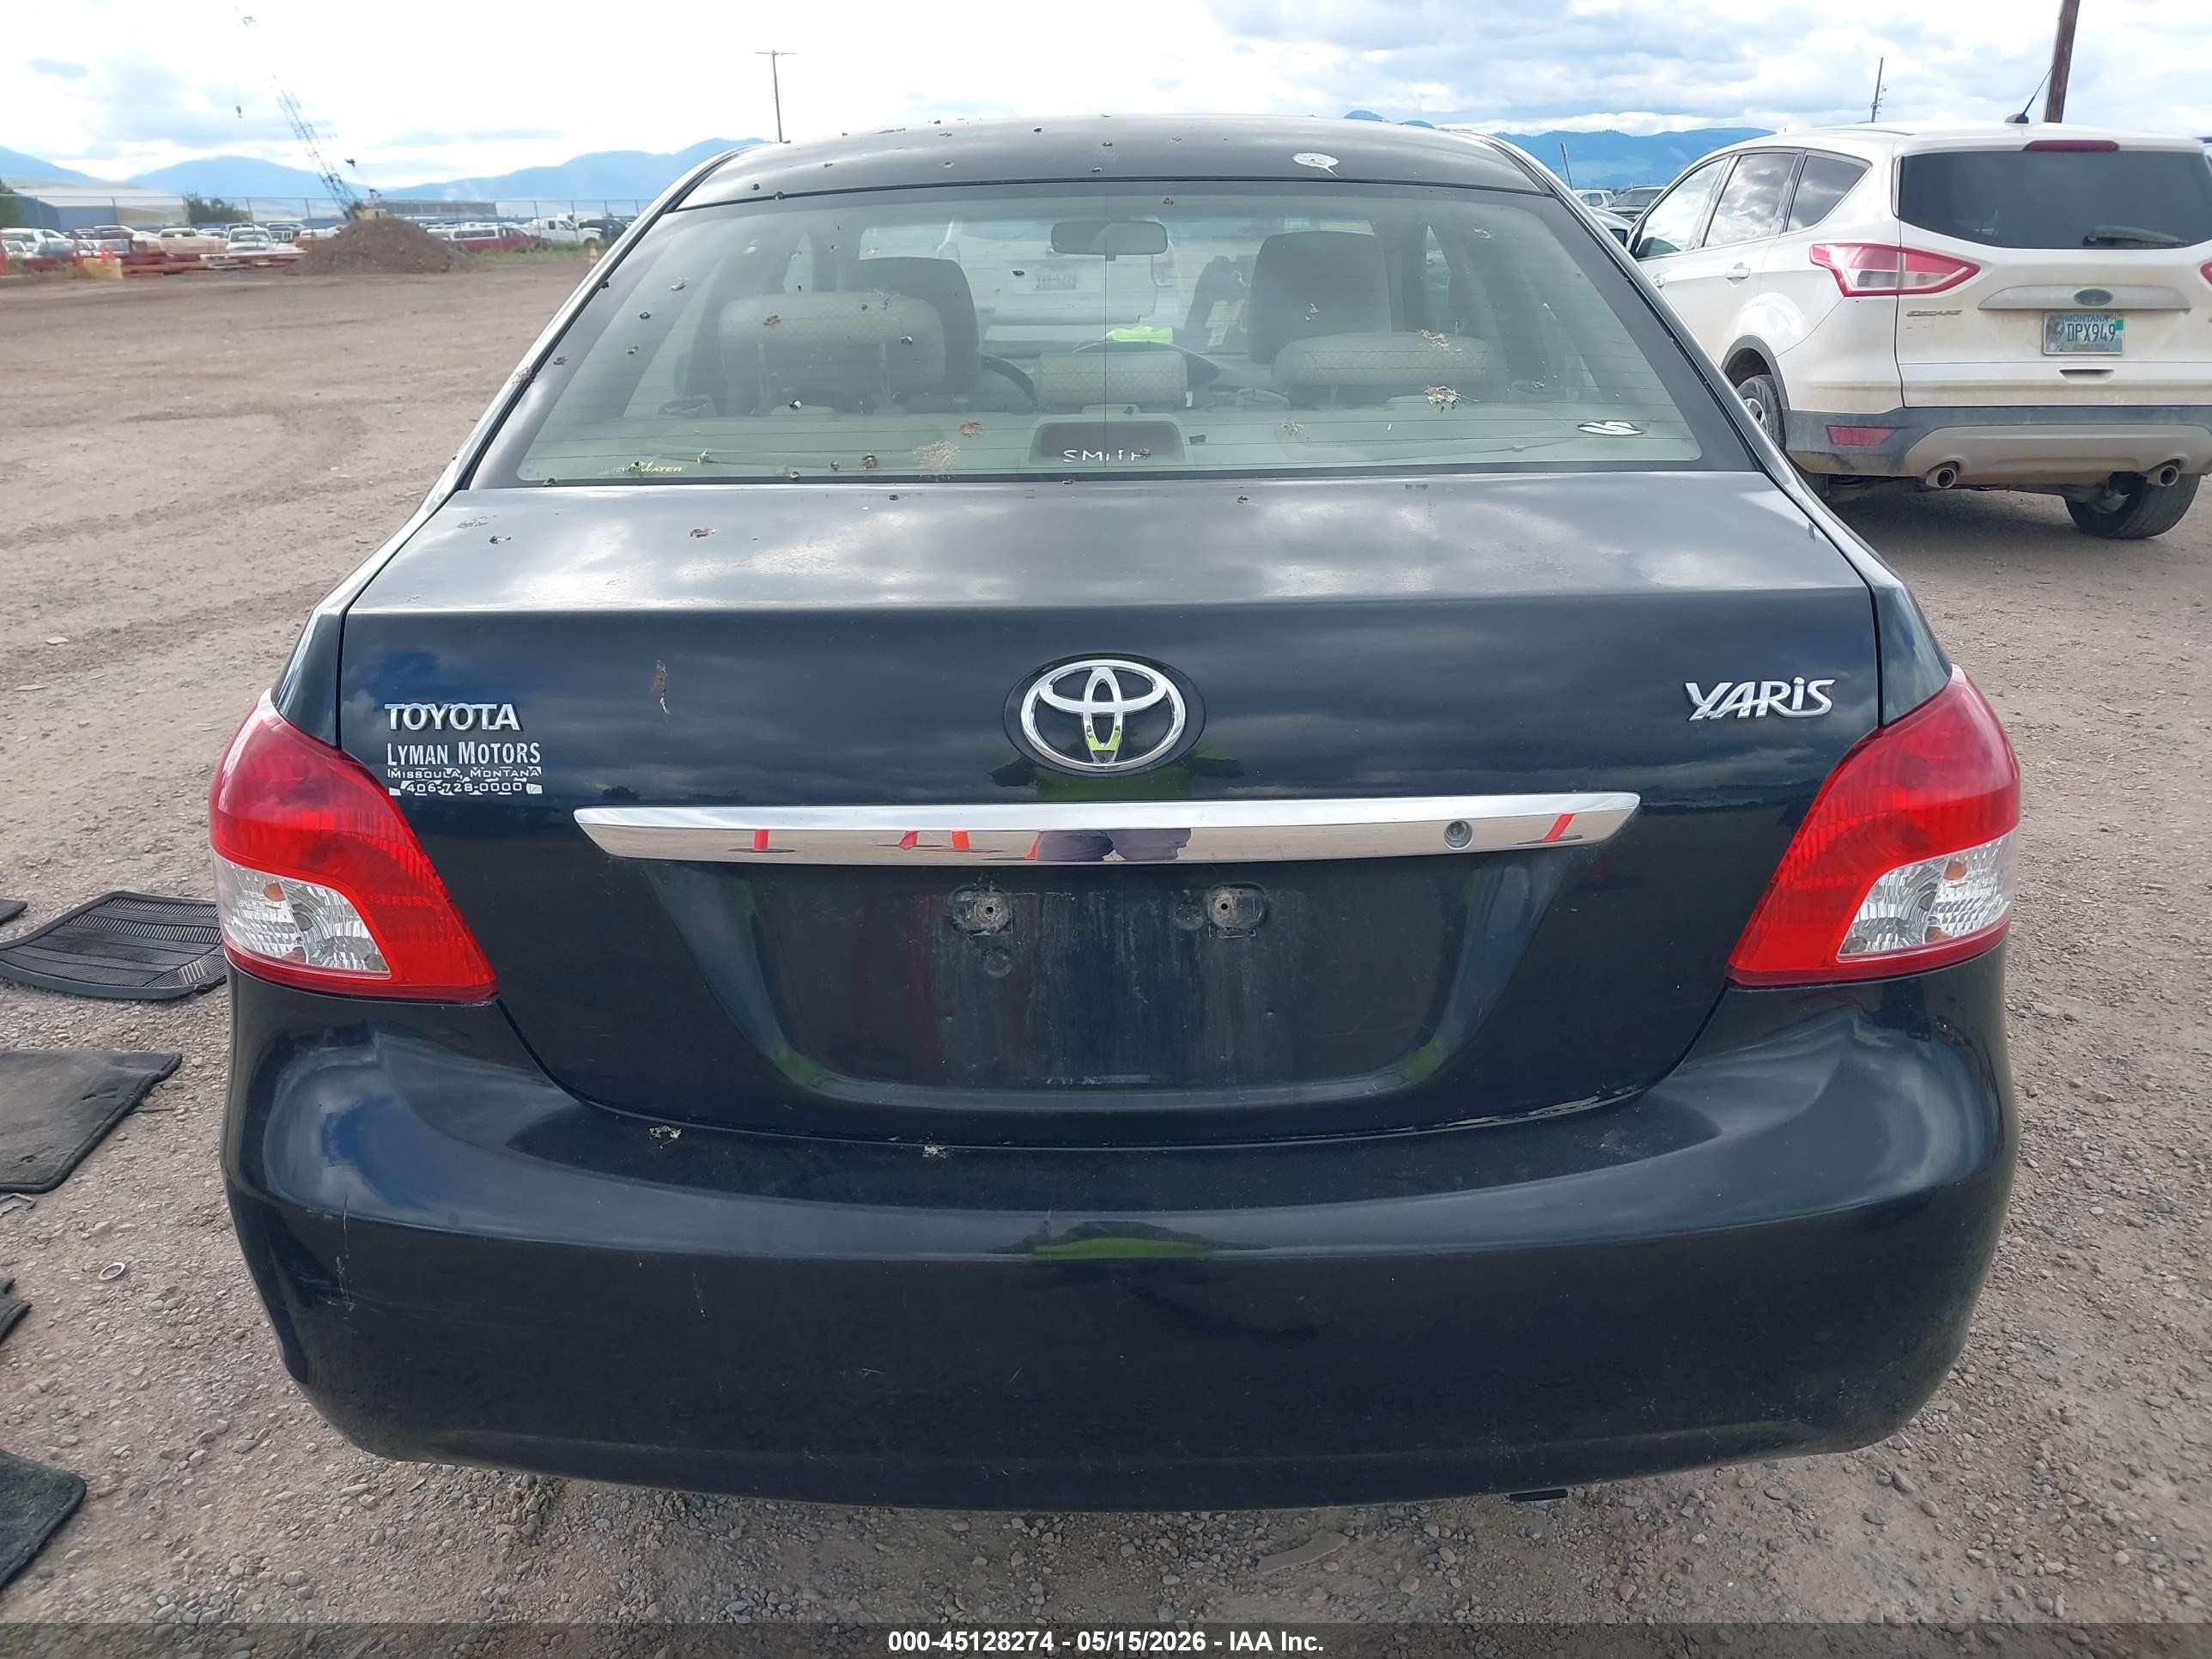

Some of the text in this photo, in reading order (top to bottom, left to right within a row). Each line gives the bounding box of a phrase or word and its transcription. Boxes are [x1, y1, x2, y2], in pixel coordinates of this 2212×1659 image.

[2067, 323, 2116, 342] DPX949
[384, 702, 521, 731] TOYOTA
[387, 741, 541, 766] LYMAN MOTORS
[406, 782, 522, 793] 406-728-0000
